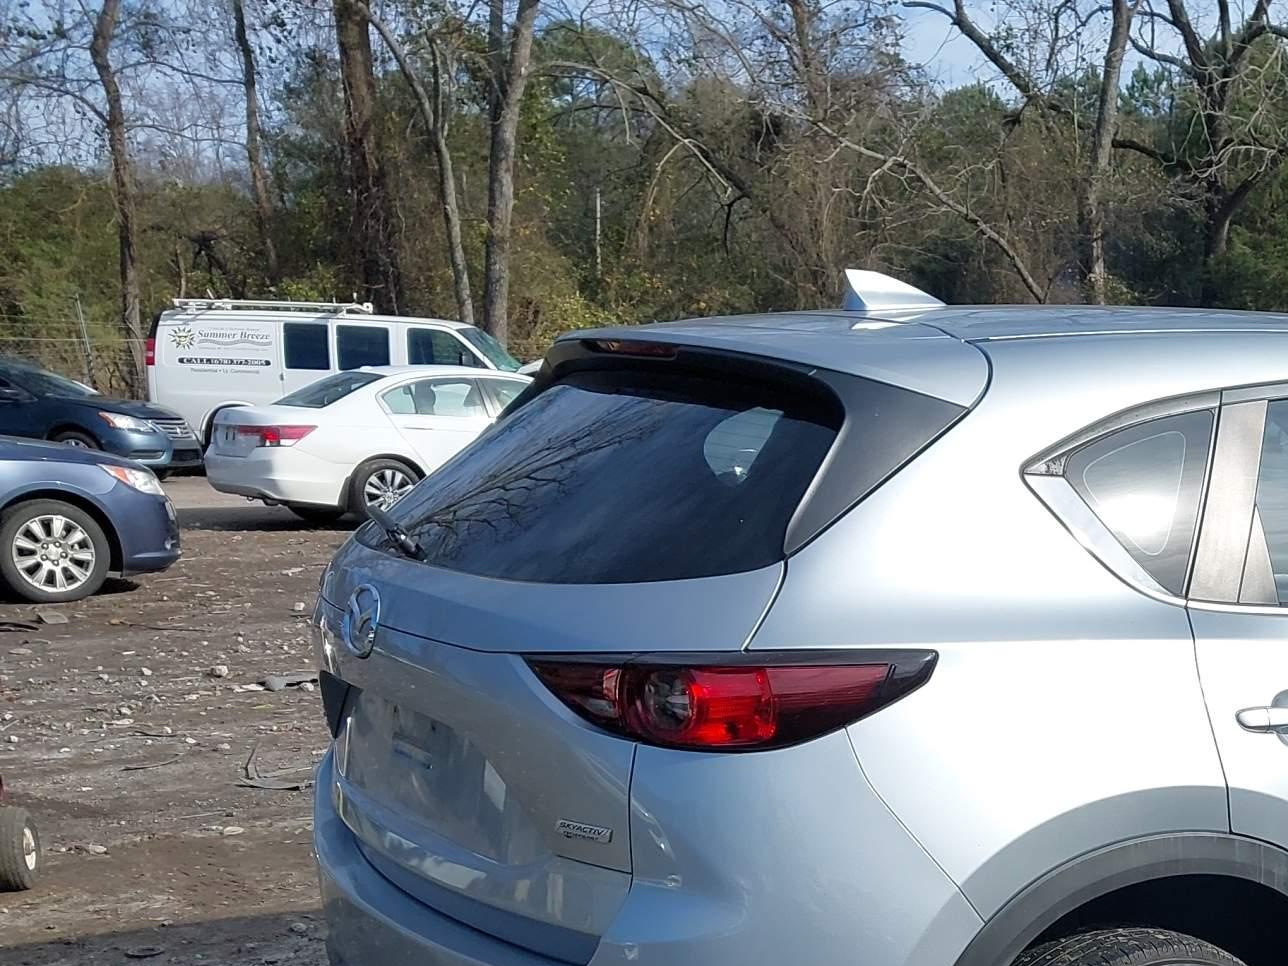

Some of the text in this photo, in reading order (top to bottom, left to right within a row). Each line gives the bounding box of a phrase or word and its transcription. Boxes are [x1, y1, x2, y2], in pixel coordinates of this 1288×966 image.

[198, 329, 237, 339] Summer
[240, 330, 271, 340] Breeze
[183, 357, 210, 365] CALL
[560, 821, 604, 836] SKYACTIV
